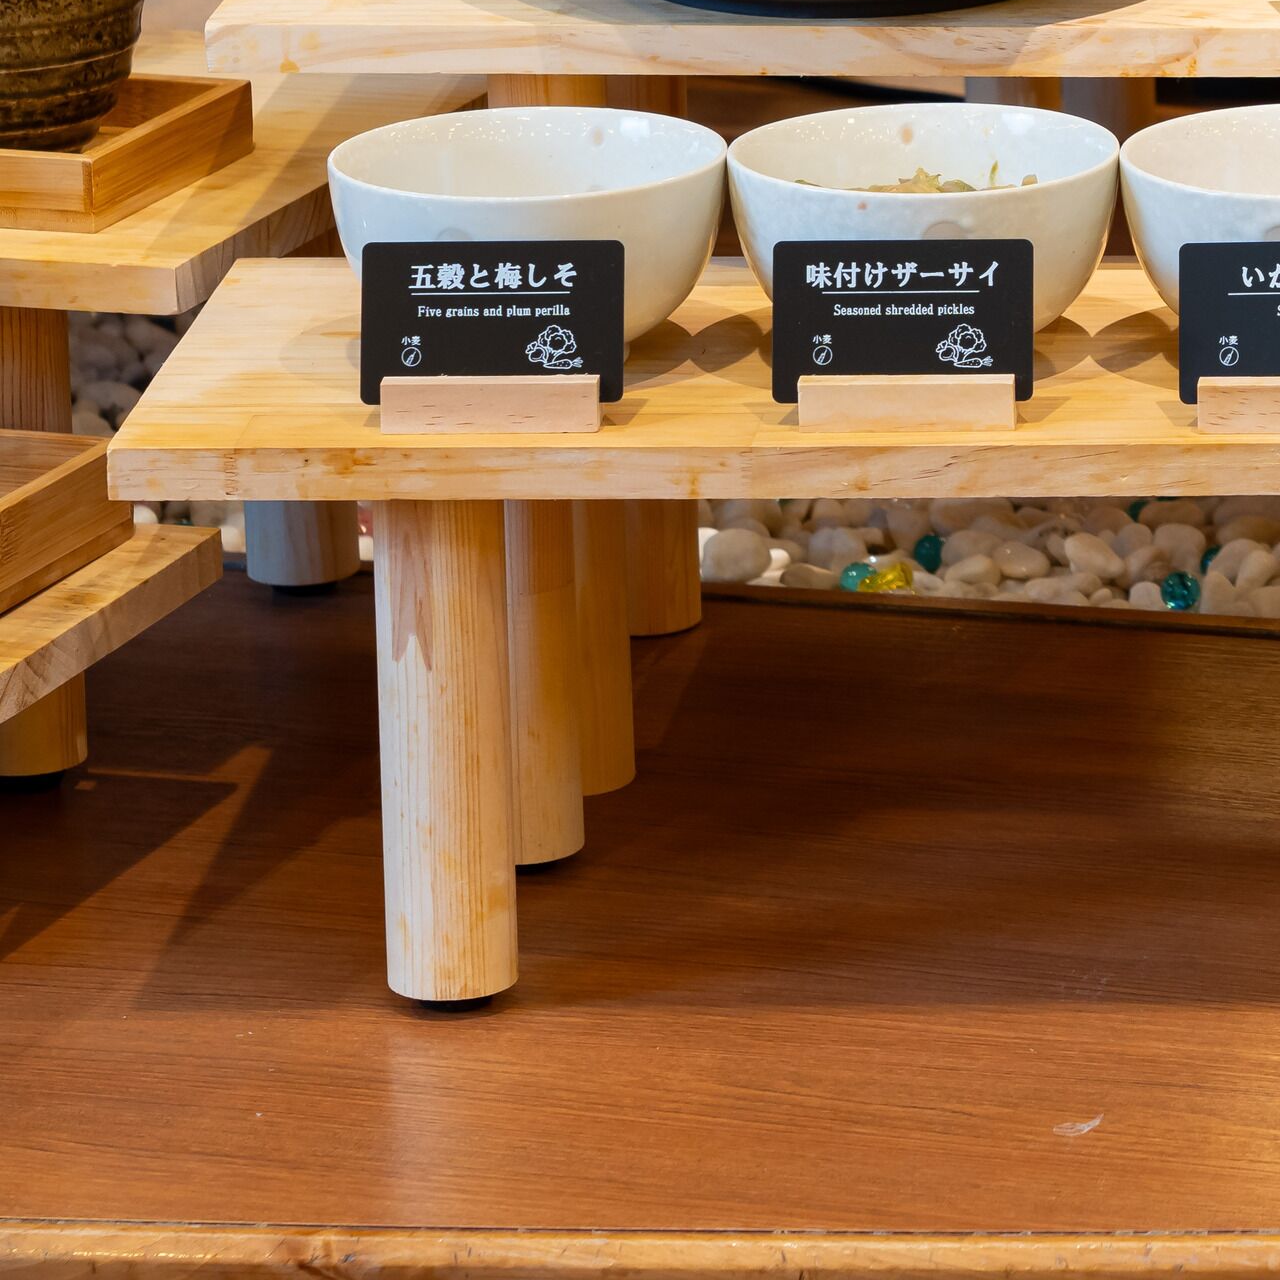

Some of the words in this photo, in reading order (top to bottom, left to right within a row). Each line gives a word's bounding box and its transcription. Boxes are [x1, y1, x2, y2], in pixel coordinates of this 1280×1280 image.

[408, 262, 578, 290] 五穀と梅しそ
[806, 260, 999, 289] 味付けザーサイ
[417, 305, 442, 318] Five
[445, 306, 480, 318] grains
[483, 304, 503, 317] and
[506, 304, 532, 318] plum
[535, 304, 571, 318] perilla
[833, 303, 882, 316] Seasoned
[885, 303, 934, 316] shredded
[937, 303, 975, 317] pickles
[401, 335, 421, 346] 小麦
[812, 334, 832, 345] 小麦
[1218, 335, 1239, 346] 小麦
